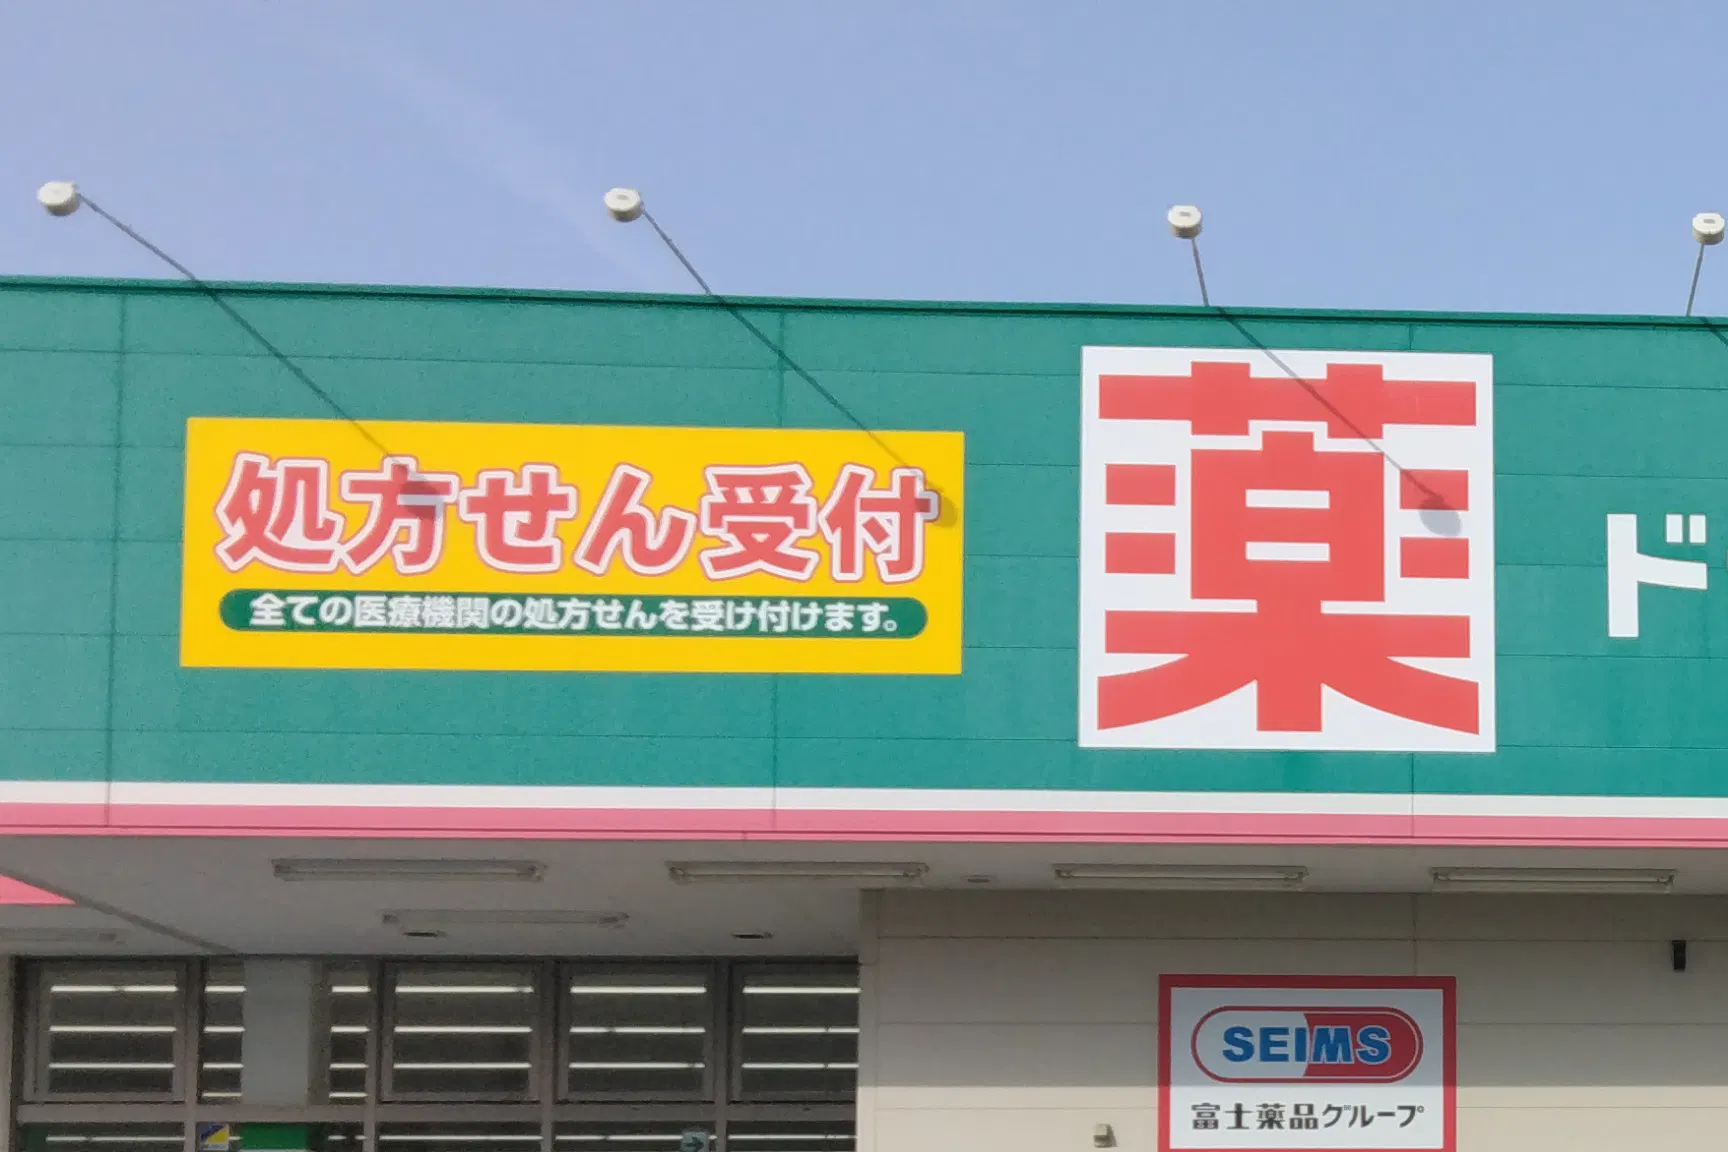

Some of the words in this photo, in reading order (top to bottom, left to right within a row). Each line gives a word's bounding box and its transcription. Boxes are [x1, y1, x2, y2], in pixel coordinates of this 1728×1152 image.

[217, 452, 940, 583] 処方せん受付
[1098, 361, 1479, 735] 薬
[249, 594, 898, 632] 全ての医療機関の処方せんを受け付けます。
[1222, 1025, 1391, 1065] SEIMS
[1191, 1103, 1424, 1130] 富士薬品グループ
